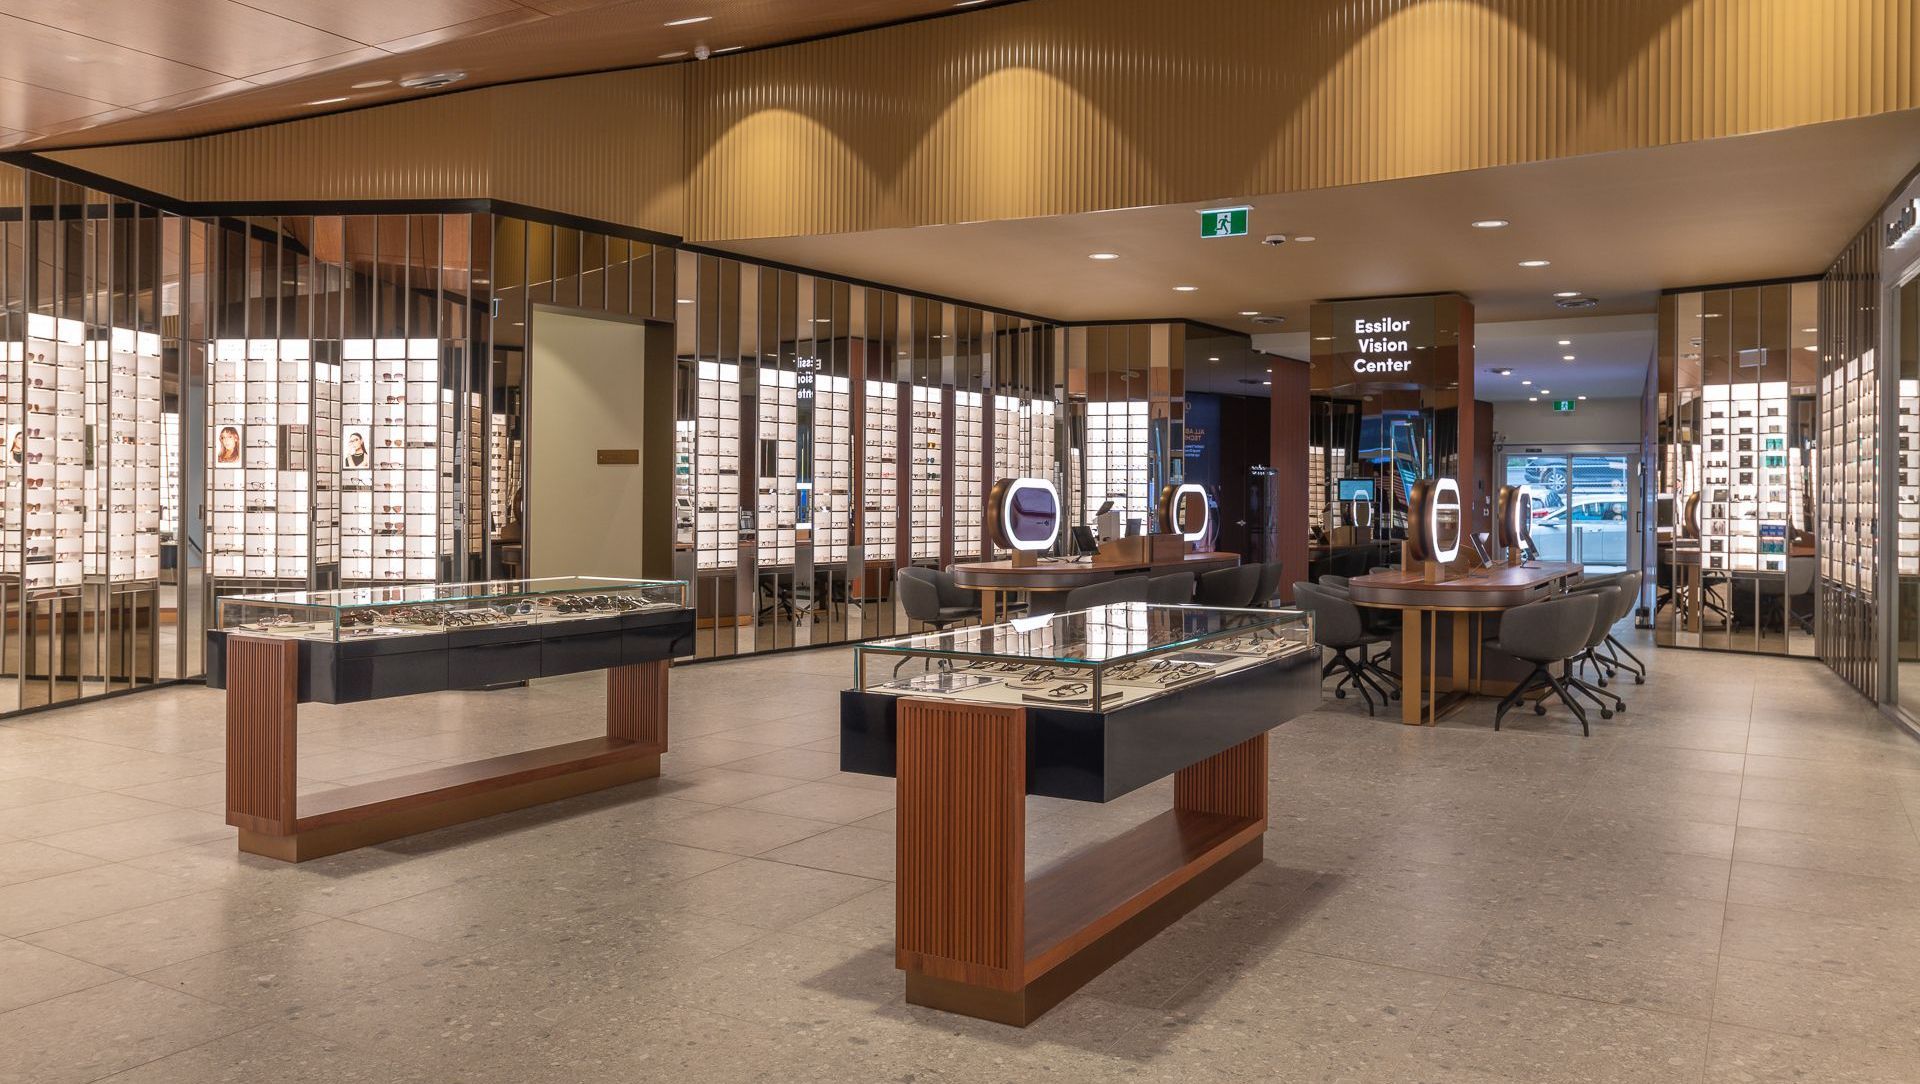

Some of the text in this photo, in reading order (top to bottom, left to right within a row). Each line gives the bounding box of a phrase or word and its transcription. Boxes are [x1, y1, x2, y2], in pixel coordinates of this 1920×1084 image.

[1355, 317, 1410, 333] Essilor
[1358, 337, 1408, 353] Vision
[1354, 358, 1411, 373] Center
